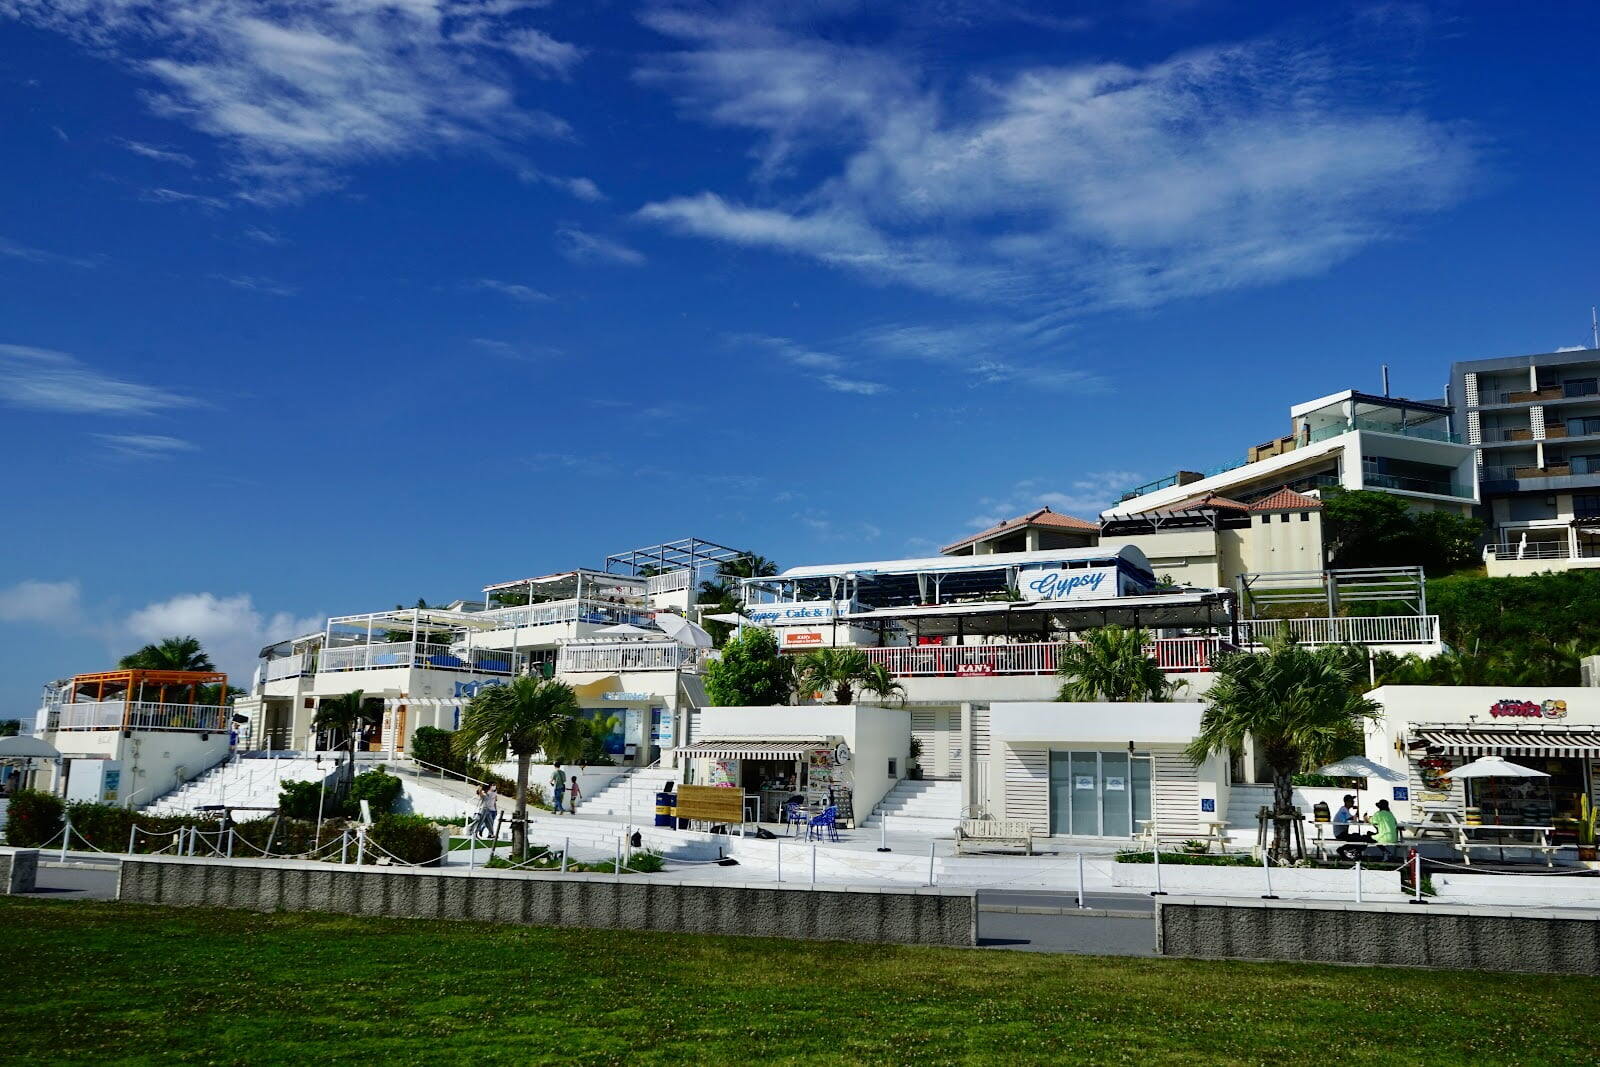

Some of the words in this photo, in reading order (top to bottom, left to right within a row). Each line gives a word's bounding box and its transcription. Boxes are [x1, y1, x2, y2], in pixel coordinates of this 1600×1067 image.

[1029, 573, 1106, 599] Gypsy
[786, 608, 811, 617] Cafe
[814, 608, 822, 617] &
[957, 664, 991, 673] KAN's
